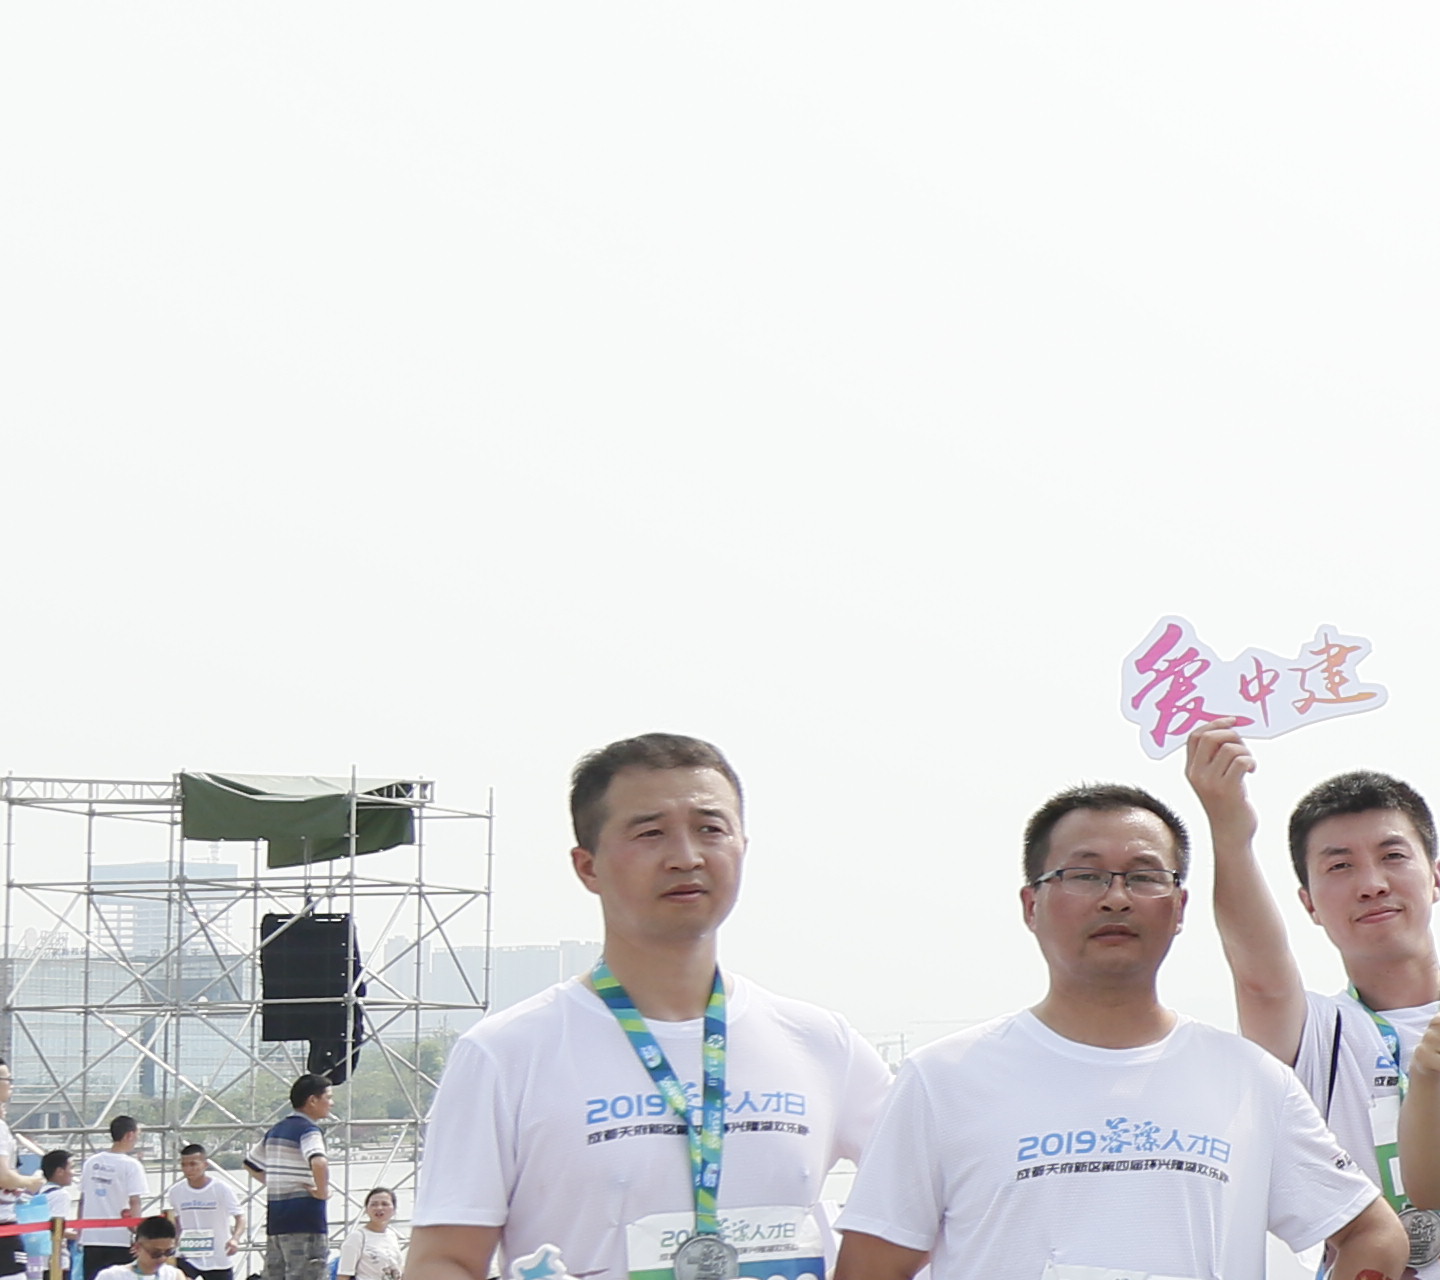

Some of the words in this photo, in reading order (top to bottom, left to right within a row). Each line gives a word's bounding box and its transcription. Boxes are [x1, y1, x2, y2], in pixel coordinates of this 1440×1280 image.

[1131, 623, 1377, 749] 爱中建
[1017, 1116, 1232, 1164] 2019蓉漂人才日
